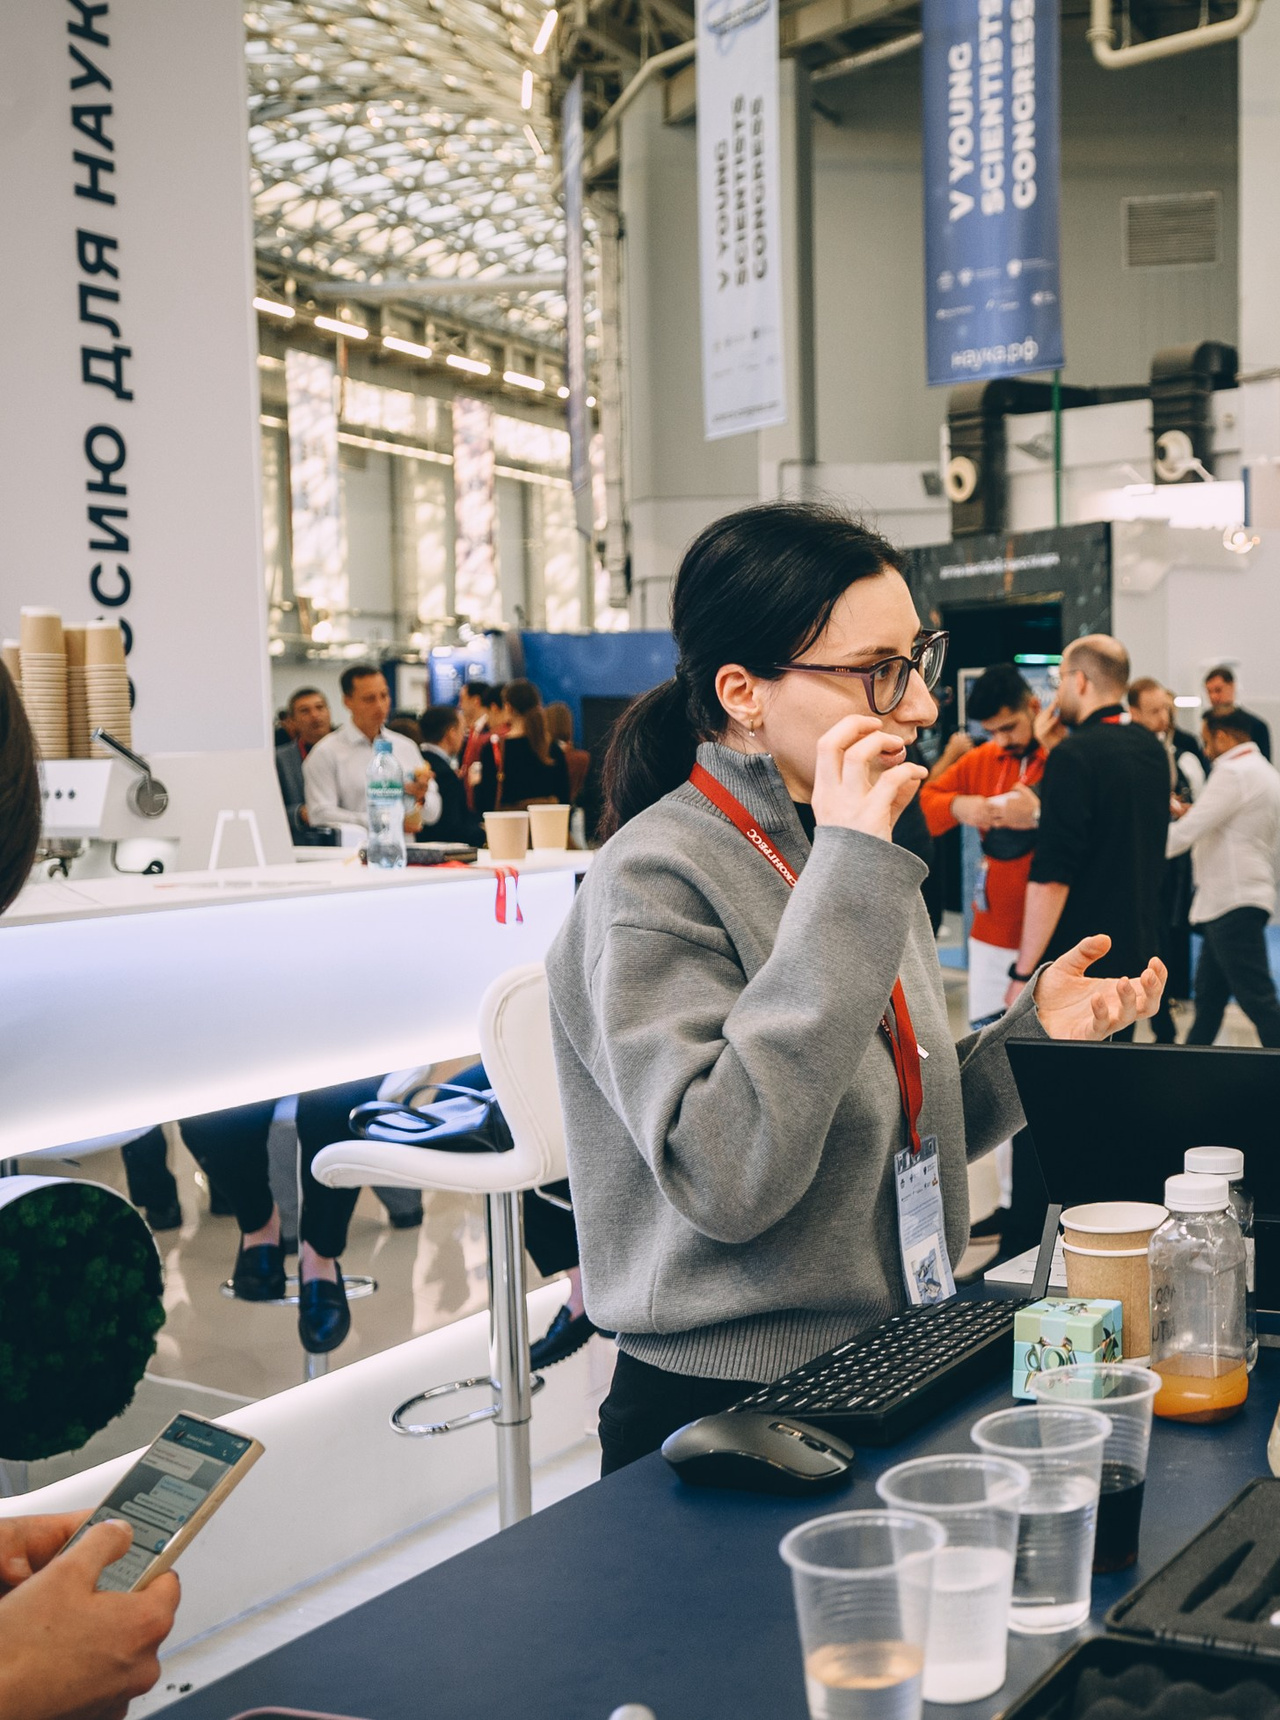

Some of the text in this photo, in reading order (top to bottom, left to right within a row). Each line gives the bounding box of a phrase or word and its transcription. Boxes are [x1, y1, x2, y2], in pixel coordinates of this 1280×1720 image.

[733, 94, 747, 286] SCIENTISTS
[752, 95, 767, 280] CONGRESS
[947, 42, 975, 222] V YOUNG
[1010, 0, 1038, 209] CONGRESS
[714, 138, 730, 260] YOUNG
[76, 228, 133, 402] ДЛЯ
